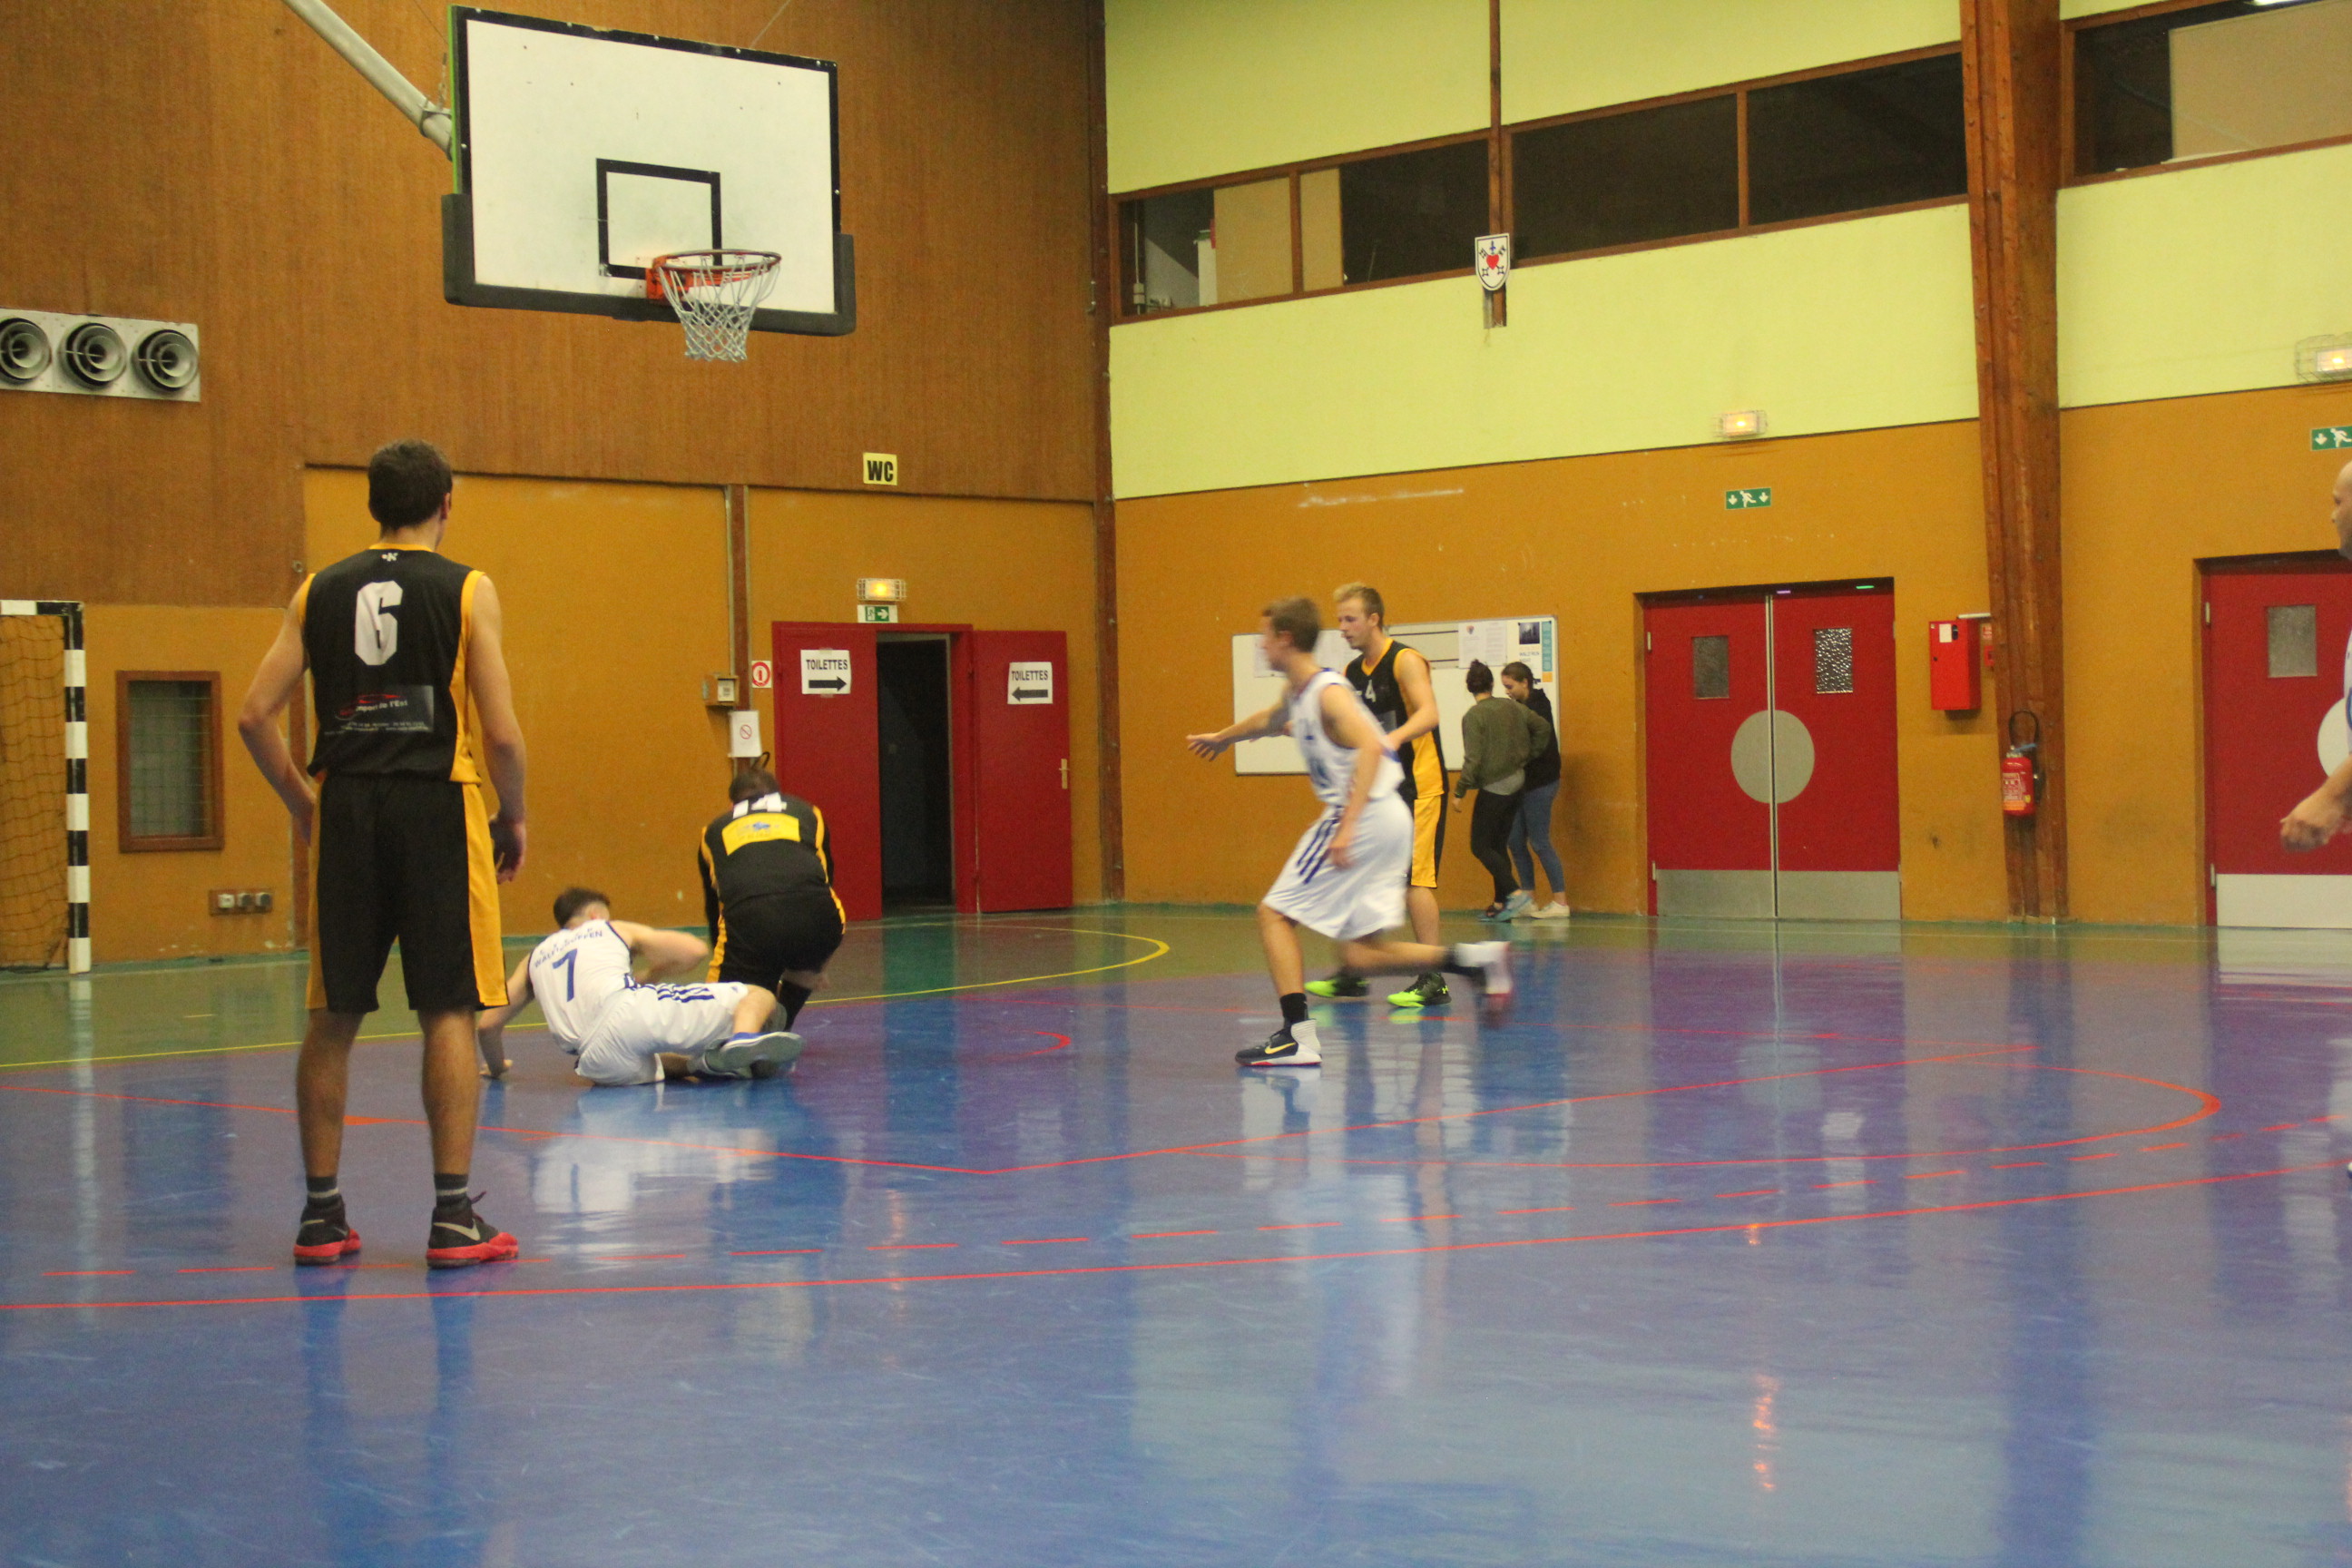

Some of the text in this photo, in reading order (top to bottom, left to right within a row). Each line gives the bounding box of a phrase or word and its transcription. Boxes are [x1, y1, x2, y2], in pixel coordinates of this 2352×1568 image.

[867, 460, 894, 482] WC
[355, 580, 403, 666] 6
[806, 660, 848, 670] TOILETTES
[1012, 671, 1048, 681] TOILETTES
[552, 948, 577, 1002] 7
